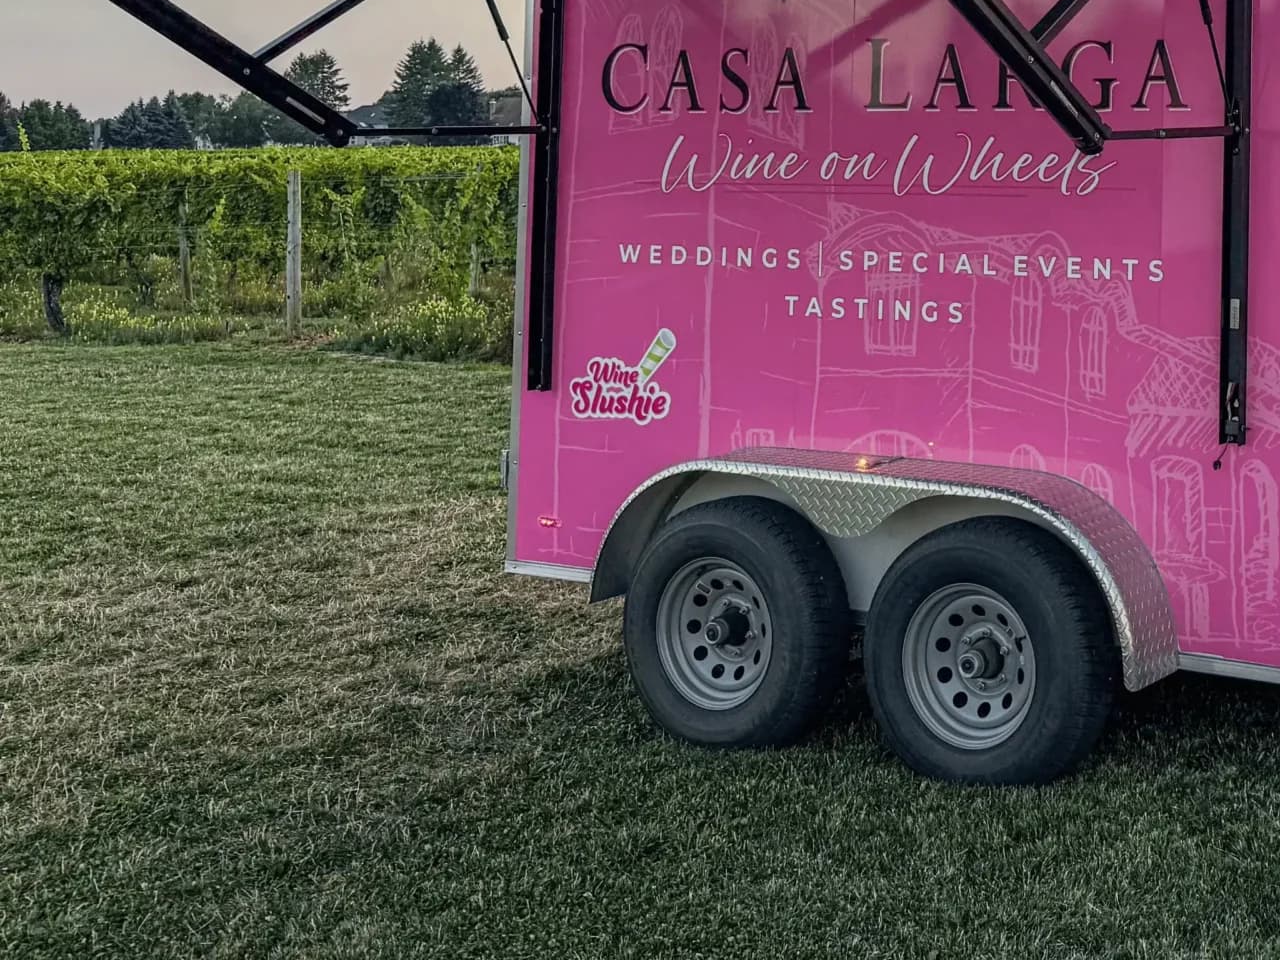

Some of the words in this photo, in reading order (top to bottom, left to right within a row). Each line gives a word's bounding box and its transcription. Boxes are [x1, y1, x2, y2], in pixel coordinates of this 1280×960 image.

[602, 43, 814, 115] CASA
[660, 133, 809, 194] Wine
[819, 151, 888, 181] on
[893, 134, 1117, 197] Wheels
[618, 243, 801, 269] WEDDINGS
[839, 250, 998, 276] SPECIAL
[1013, 255, 1165, 283] EVENTS
[784, 295, 964, 324] TASTINGS
[589, 360, 639, 388] Wine
[571, 381, 667, 421] Slushie
